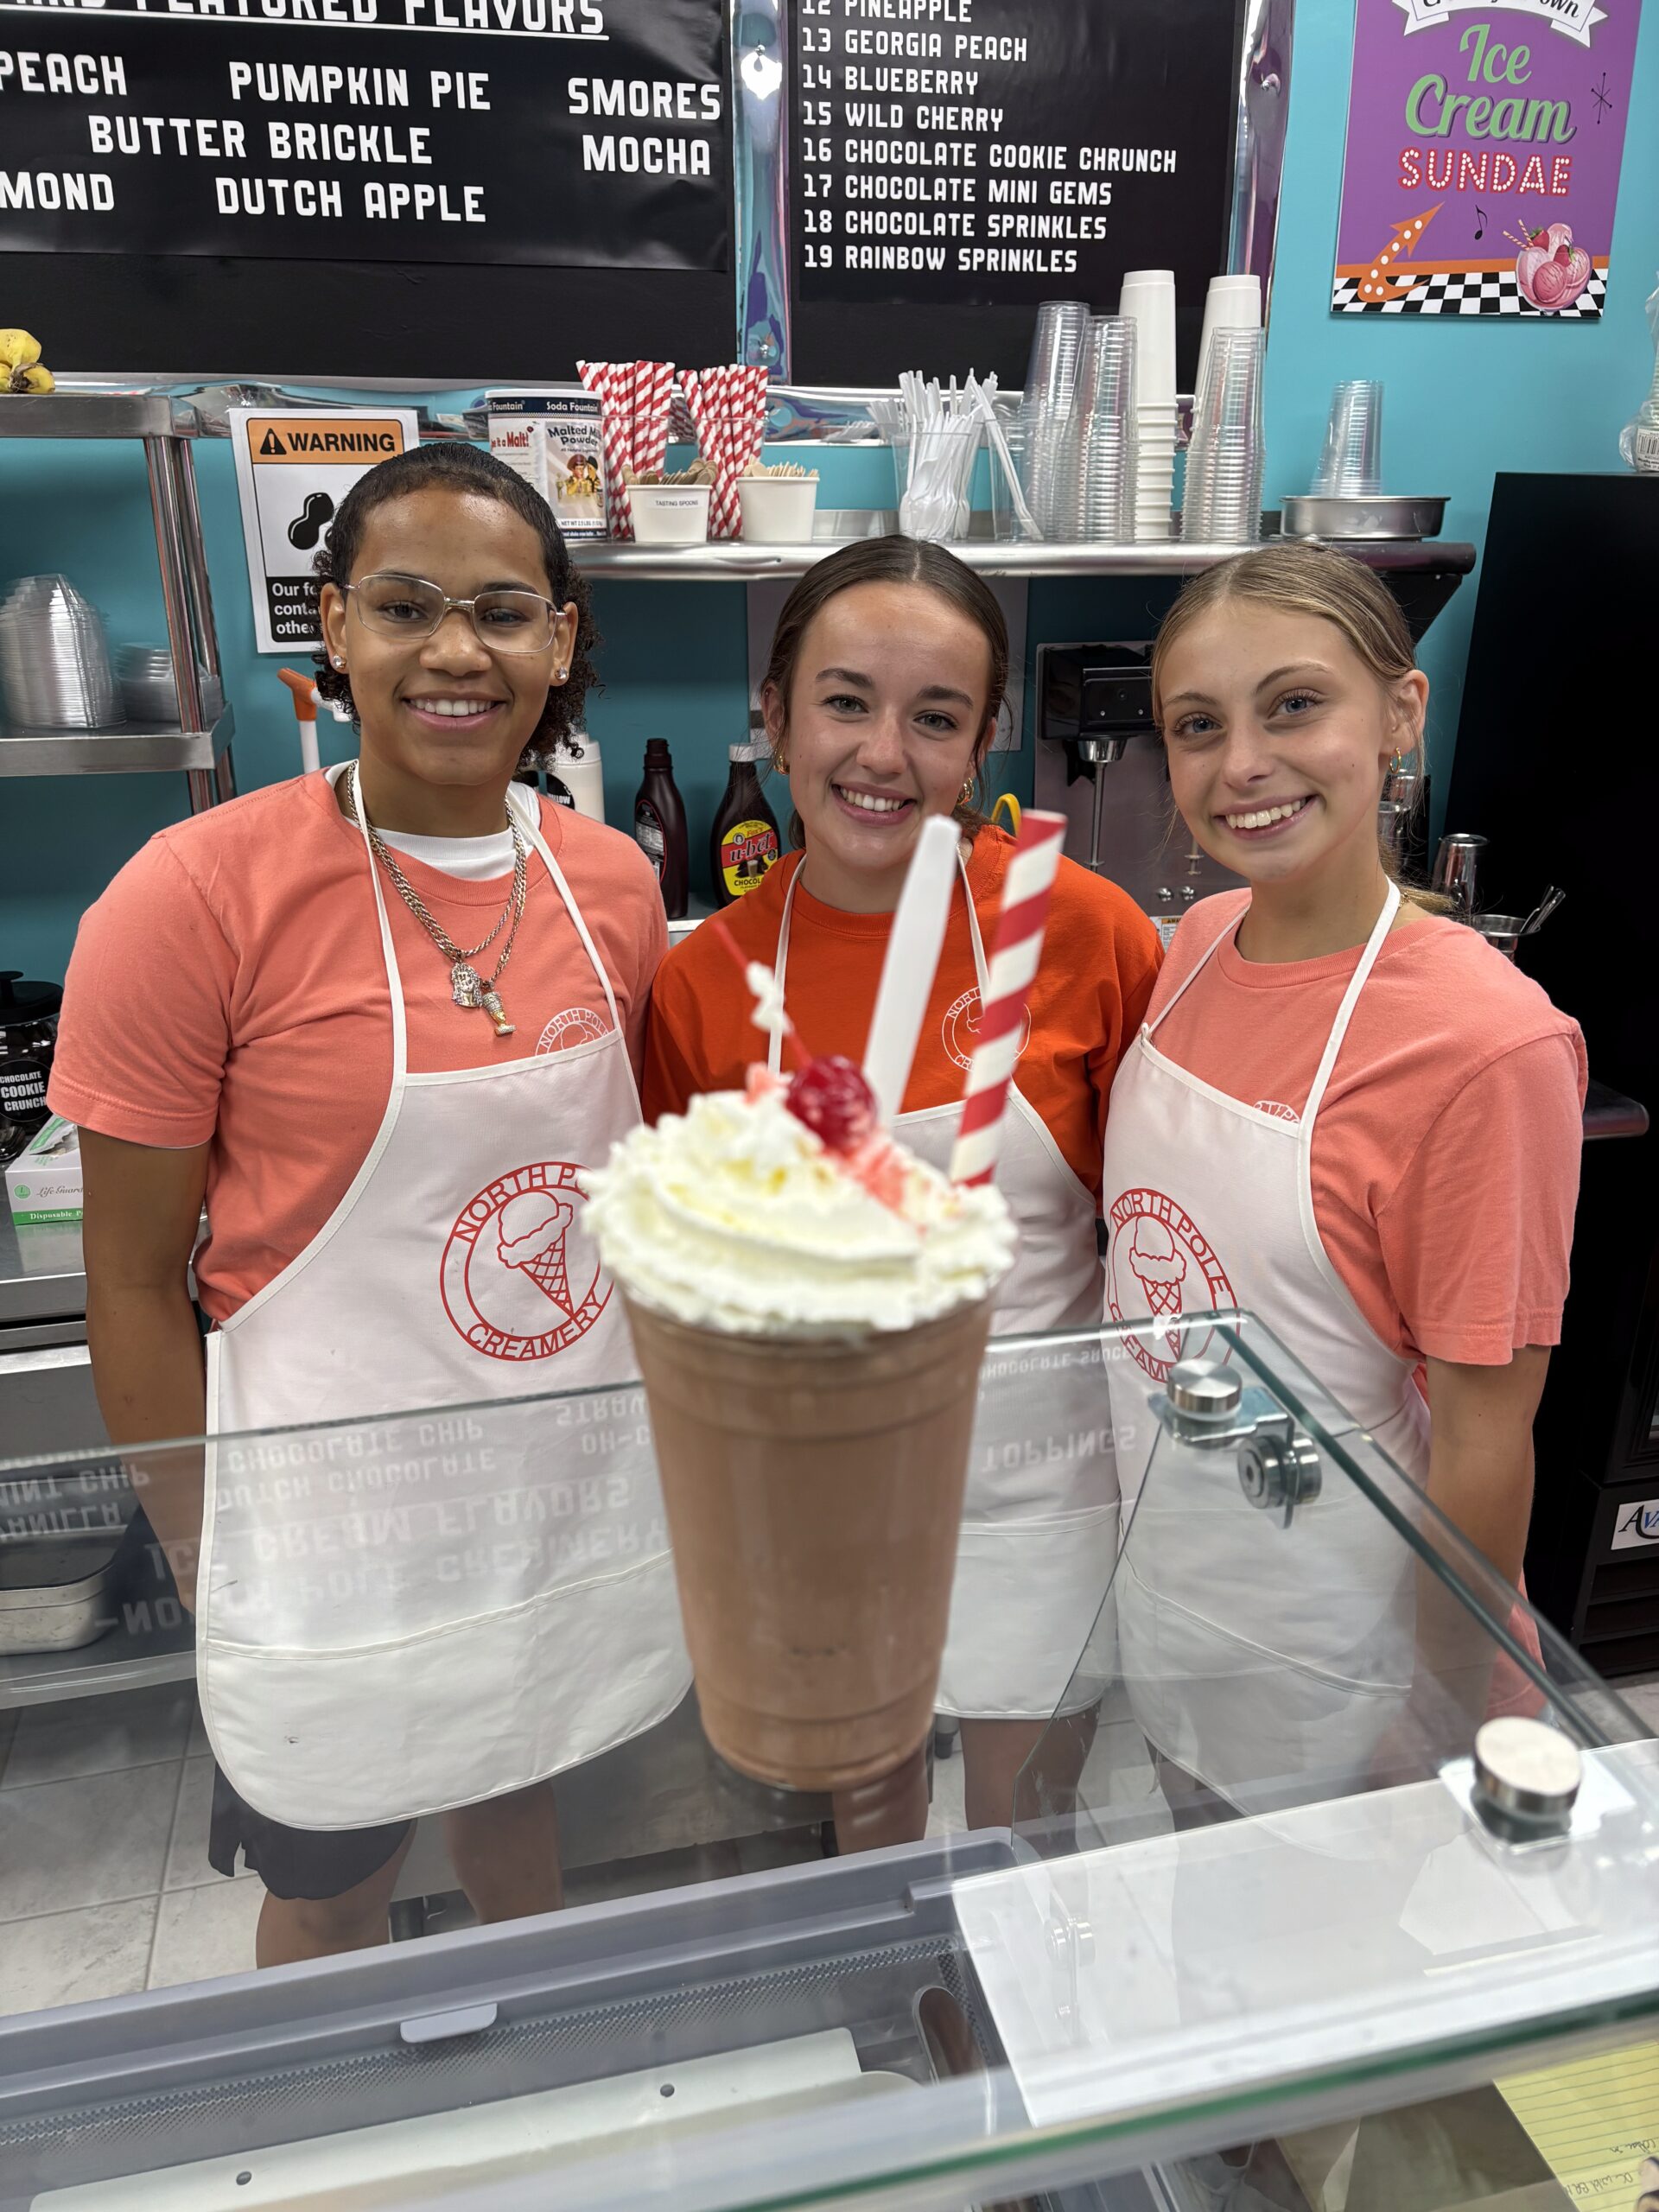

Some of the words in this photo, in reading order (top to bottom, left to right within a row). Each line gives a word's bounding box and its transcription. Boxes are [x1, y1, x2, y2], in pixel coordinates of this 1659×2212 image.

[405, 0, 603, 34] FLAVORS
[803, 0, 830, 15] 12
[845, 0, 971, 22] PINEAPPLE
[803, 28, 830, 52] 13
[845, 29, 941, 57] GEORGIA
[956, 35, 1027, 61] PEACH
[1459, 24, 1532, 85] Ice
[230, 62, 409, 105] PUMPKIN
[431, 71, 490, 110] PIE
[803, 64, 830, 88] 14
[845, 67, 977, 95] BLUEBERRY
[569, 78, 720, 119] SMORES
[1405, 73, 1577, 144] Cream
[804, 101, 831, 125] 15
[846, 103, 903, 128] WILD
[917, 105, 1002, 131] CHERRY
[89, 116, 246, 157] BUTTER
[269, 123, 431, 163] BRICKLE
[583, 135, 709, 175] MOCHA
[804, 137, 831, 162] 16
[846, 139, 976, 166] CHOCOLATE
[990, 144, 1066, 169] COOKIE
[1080, 148, 1176, 172] CHRUNCH
[1398, 146, 1573, 196] SUNDAE
[216, 178, 342, 217] DUTCH
[365, 182, 486, 222] APPLE
[804, 174, 831, 197] 17
[846, 175, 976, 201] CHOCOLATE
[988, 180, 1037, 203] MINI
[1050, 181, 1111, 205] GEMS
[804, 209, 831, 232] 18
[846, 211, 975, 236] CHOCOLATE
[988, 214, 1106, 238] SPRINKLES
[805, 245, 832, 267] 19
[846, 245, 945, 270] RAINBOW
[958, 248, 1077, 272] SPRINKLES
[546, 401, 568, 410] Soda
[570, 402, 598, 411] Fountain
[287, 432, 395, 452] WARNING
[507, 431, 530, 448] Malt!
[547, 425, 587, 438] Malted
[560, 435, 599, 447] Powder
[271, 582, 300, 596] Our
[539, 1009, 581, 1049] NORTH
[584, 1009, 609, 1037] POL
[0, 1071, 41, 1084] CHOCOLATE
[0, 1081, 46, 1098] COOKIE
[3, 1096, 47, 1112] CRUNCH
[30, 1211, 73, 1220] Disposable
[454, 1165, 546, 1244] NORTH
[1110, 1192, 1172, 1228] NORTH
[1176, 1214, 1231, 1294] POLE
[467, 1288, 603, 1360] CREAMERY
